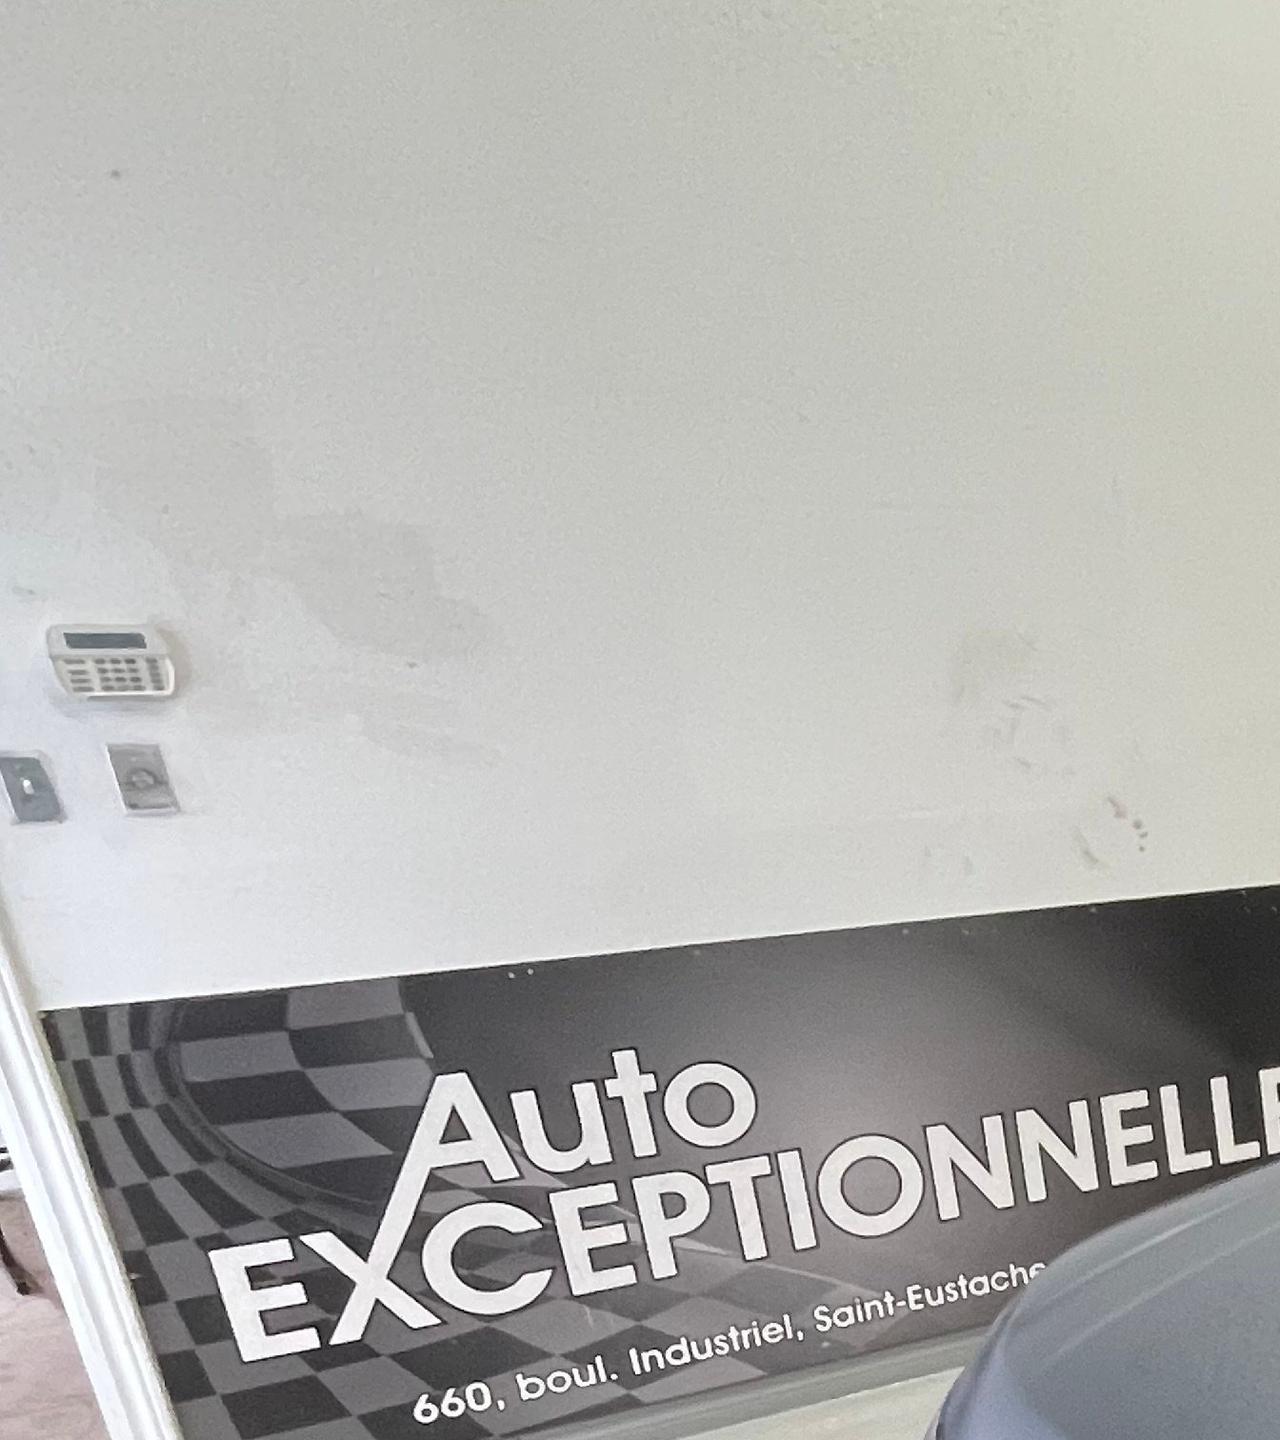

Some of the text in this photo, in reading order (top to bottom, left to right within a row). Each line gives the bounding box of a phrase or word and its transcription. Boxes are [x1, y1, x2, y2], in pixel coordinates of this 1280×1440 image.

[389, 1048, 757, 1200] Auto
[412, 1380, 506, 1425] 660,
[515, 1355, 619, 1402] boul.
[628, 1313, 805, 1377] Industriel,
